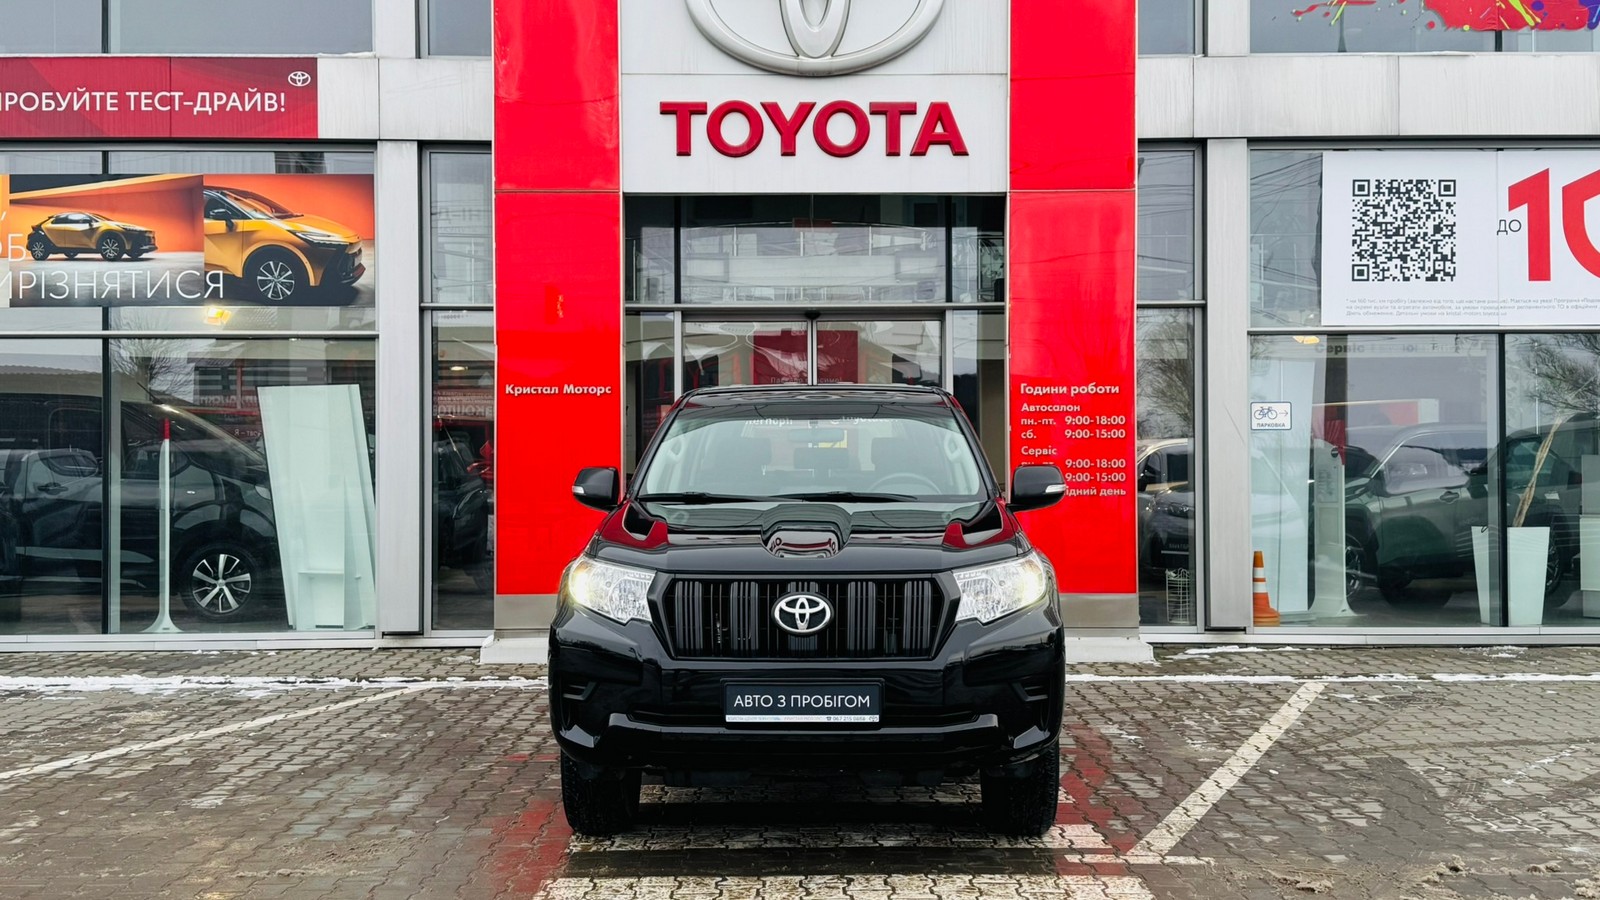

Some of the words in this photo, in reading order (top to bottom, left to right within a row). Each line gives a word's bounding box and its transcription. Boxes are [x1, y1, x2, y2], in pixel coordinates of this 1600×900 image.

[126, 87, 286, 115] ТЕСТ-ДРАЙВ!
[659, 100, 969, 158] TOYOTA
[1496, 219, 1522, 236] ДО
[0, 233, 27, 262] Б
[505, 383, 559, 396] Кристал
[563, 383, 612, 396] Моторс
[1020, 383, 1067, 396] Години
[1070, 382, 1120, 397] роботи
[1021, 403, 1081, 412] Автосалон
[1064, 415, 1126, 425] 9:00-18:00
[1021, 429, 1037, 439] сб.
[1064, 429, 1126, 439] 9:00-15:00
[1021, 445, 1057, 457] Сервіс
[1065, 459, 1126, 468] 9:00-18:00
[1065, 472, 1126, 482] 9:00-15:00
[1064, 486, 1097, 496] ідний
[1099, 488, 1127, 497] день
[734, 694, 773, 707] АВТО
[777, 694, 787, 708] З
[791, 694, 871, 708] ПРОБІГОМ
